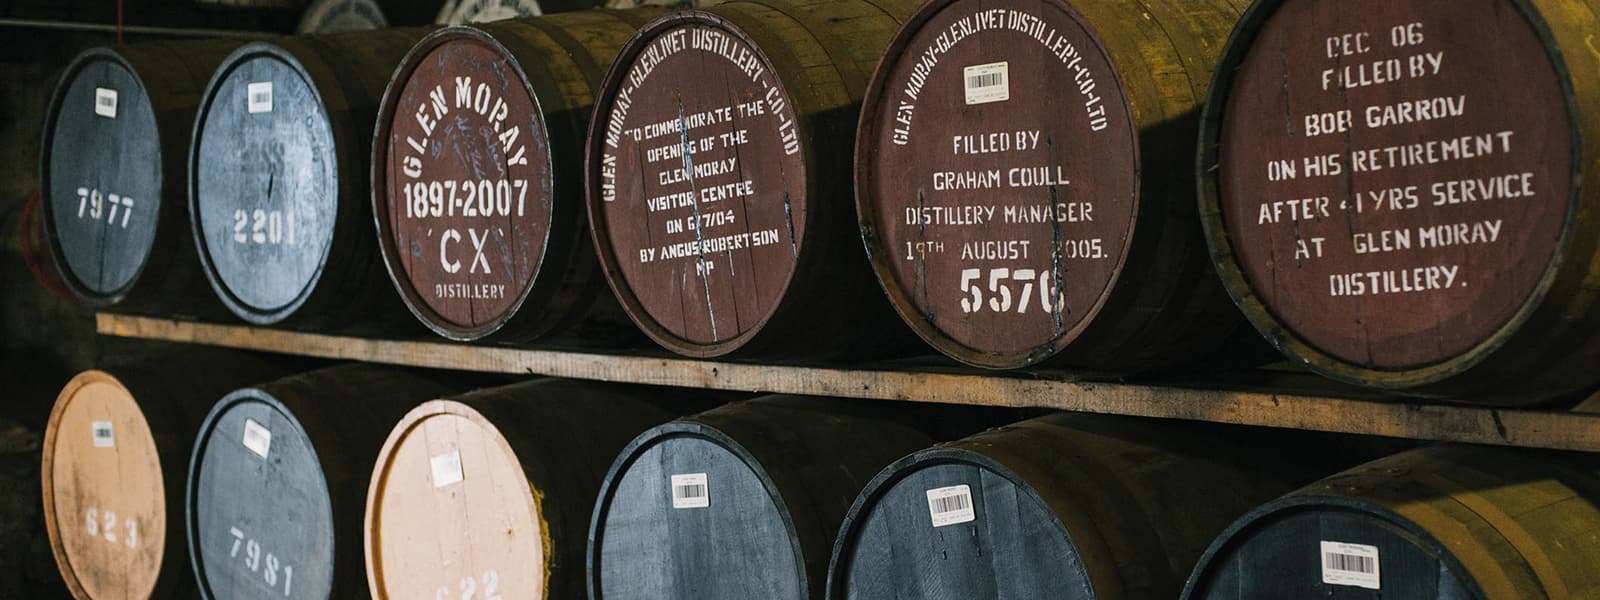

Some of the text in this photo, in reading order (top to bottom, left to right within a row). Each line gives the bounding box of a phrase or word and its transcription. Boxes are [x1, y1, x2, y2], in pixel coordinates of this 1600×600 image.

[1326, 22, 1425, 58] DEC 06
[605, 29, 687, 149] MORAY-GLENLIVET
[892, 100, 915, 145] GLEN
[904, 9, 1006, 101] MORAY-GLENLIVET
[1322, 51, 1443, 91] FILLED BY
[403, 85, 449, 178] GLEN
[455, 76, 528, 166] MORAY
[644, 106, 732, 140] COMMEMORATE
[736, 99, 764, 119] THE
[1304, 109, 1352, 137] BOB
[700, 136, 715, 152] OF
[720, 129, 748, 147] THE
[953, 130, 1040, 155] FILLED BY
[1267, 130, 1514, 182] ON HIS RETIREMENT
[603, 153, 617, 202] GLEN
[659, 157, 736, 186] GLEN MORAY
[933, 165, 1070, 191] GRAHAM COULL
[76, 187, 134, 229] 7977
[403, 178, 528, 219] 1897-2007
[647, 180, 754, 213] VISITOR CENTRE
[906, 202, 1094, 225] DISTILLERY MANAGER
[1258, 196, 1330, 225] AFTER
[1369, 185, 1419, 213] YRS
[1431, 172, 1536, 206] SERVICE
[234, 208, 296, 244] 2201
[666, 219, 683, 234] ON
[1295, 219, 1502, 260] AT GLEN MORAY
[639, 228, 780, 264] BY ANGUS ROBERTSON
[961, 240, 1031, 261] AUGUST
[435, 283, 506, 300] DISTILLERY
[1329, 265, 1468, 298] DISTILLERY.
[86, 506, 139, 549] 623
[230, 525, 293, 597] 7981
